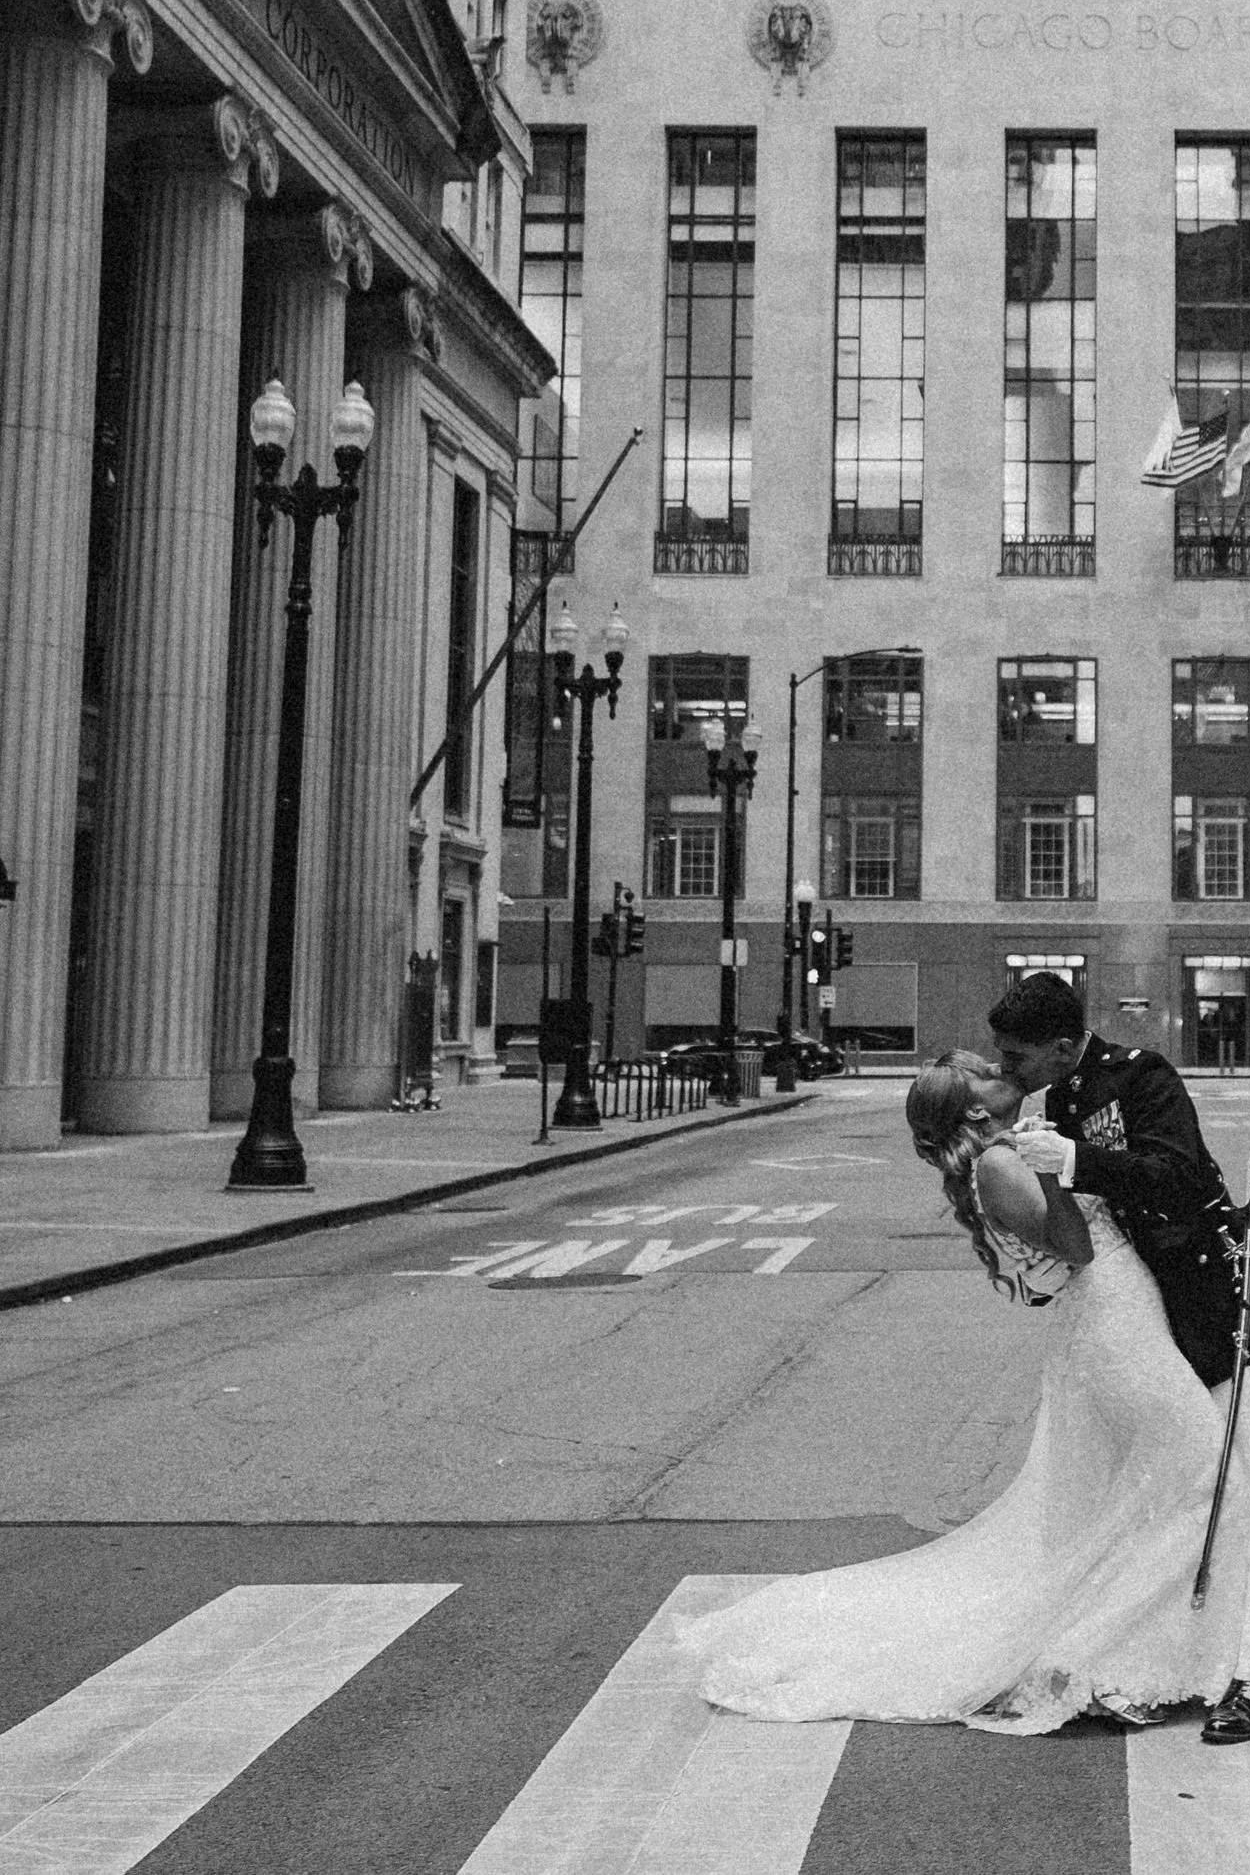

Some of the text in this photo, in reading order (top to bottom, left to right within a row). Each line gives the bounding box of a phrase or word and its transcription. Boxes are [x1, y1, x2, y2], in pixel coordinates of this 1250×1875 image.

[874, 10, 1113, 53] CHICAGO
[565, 1202, 840, 1226] BUS
[392, 1237, 818, 1278] LANE
